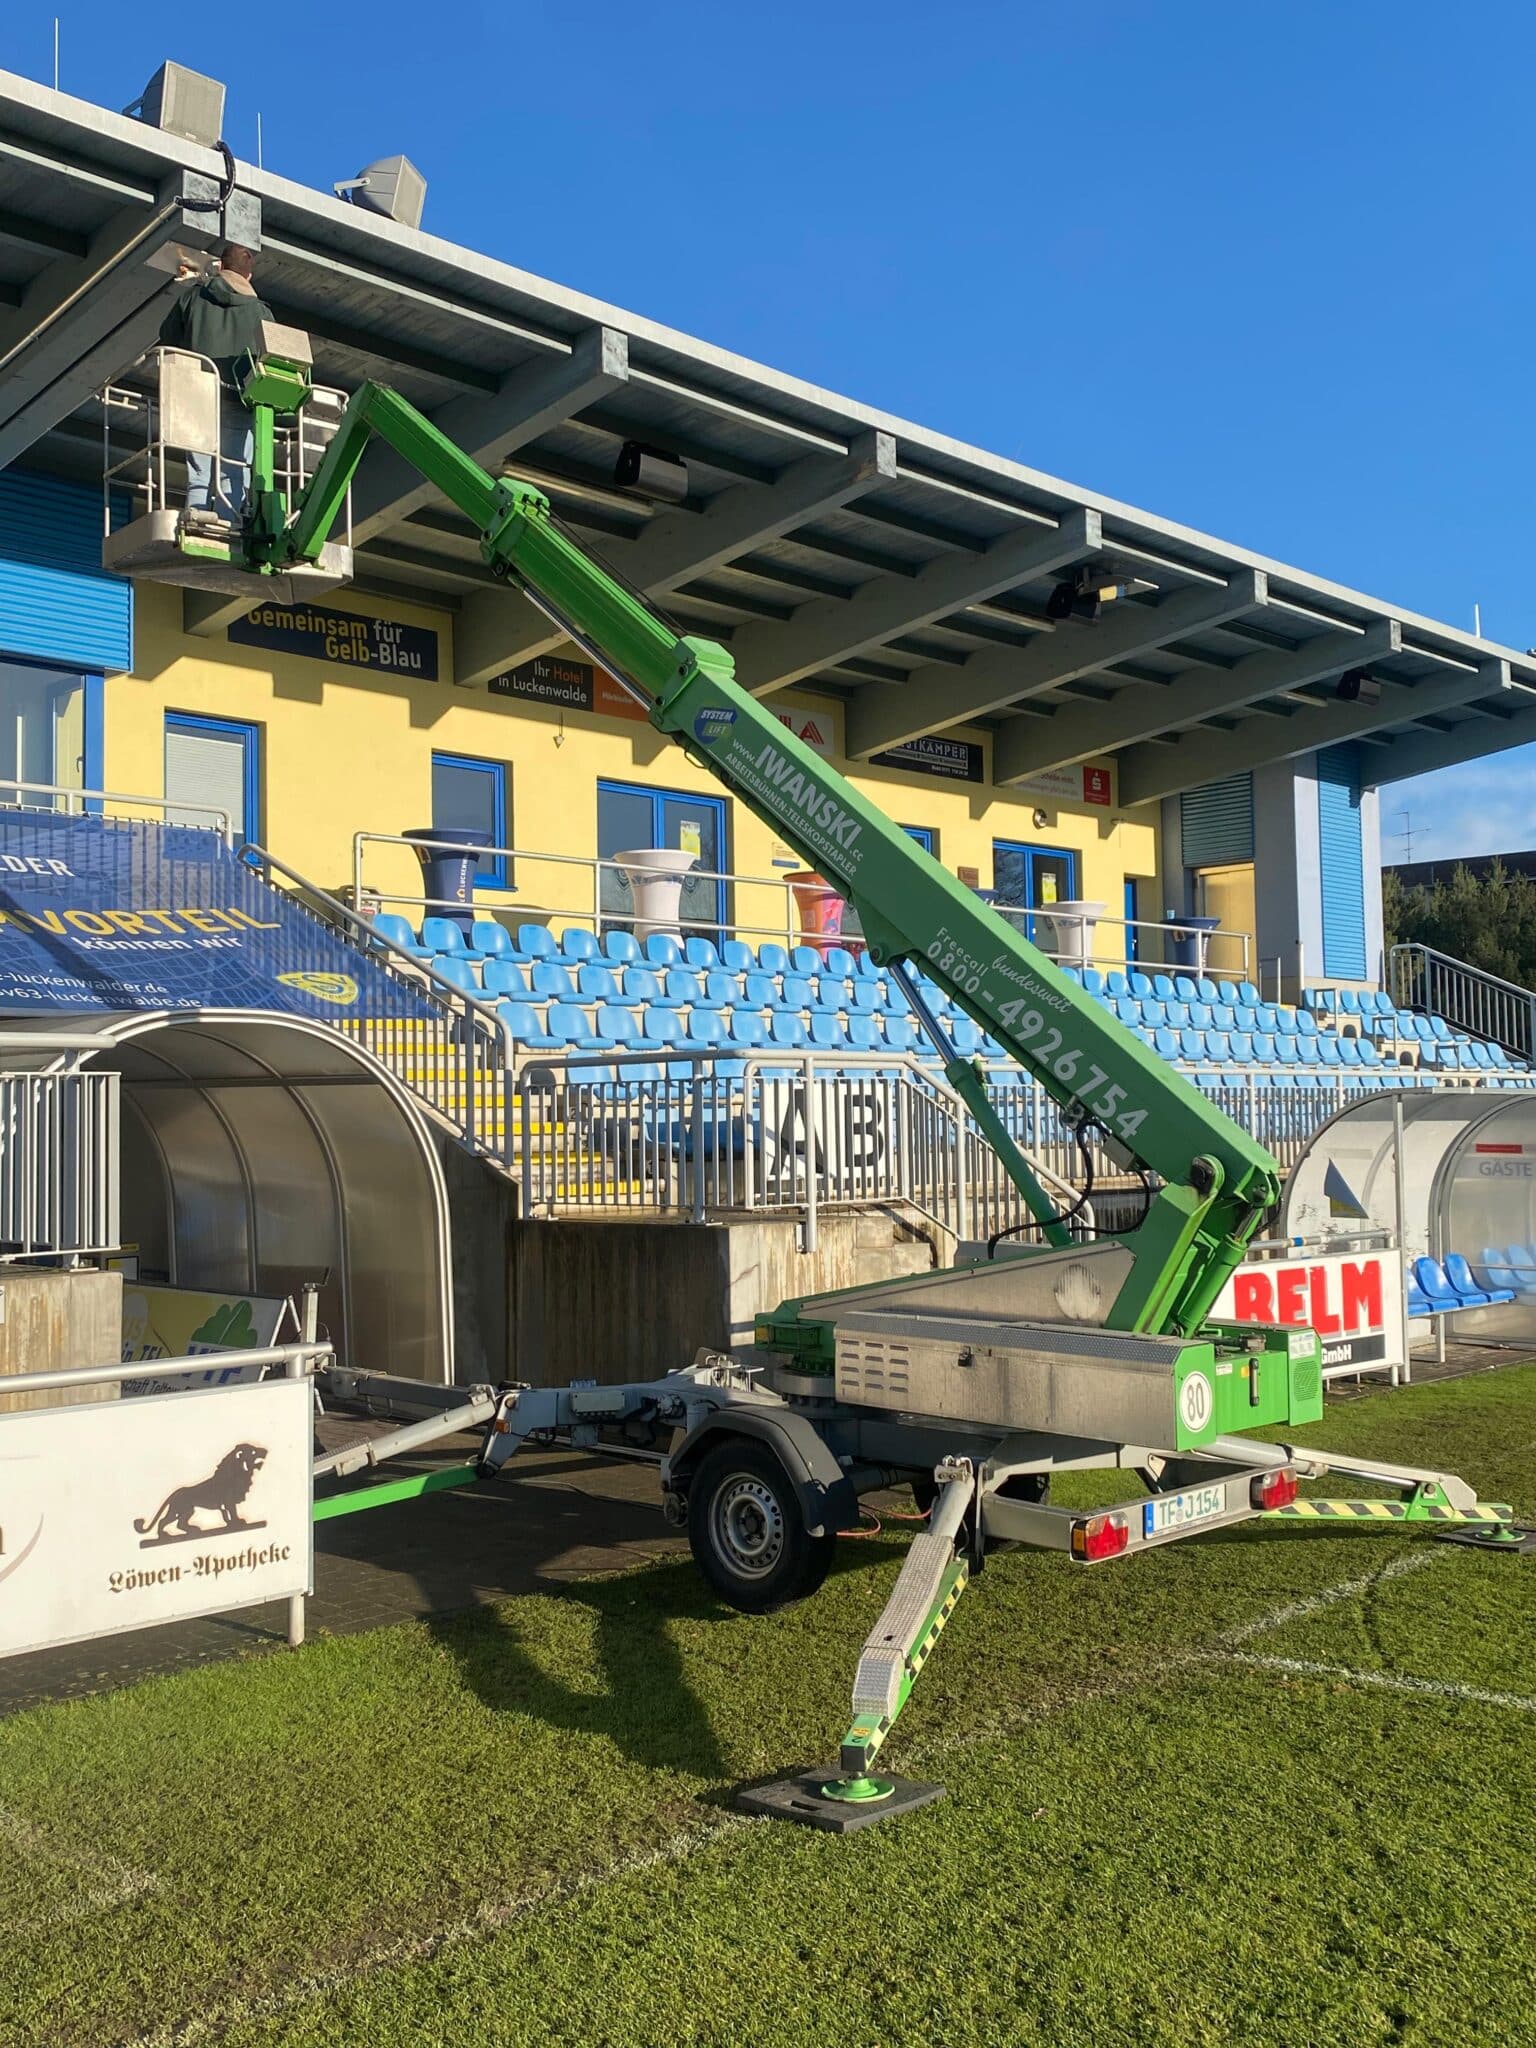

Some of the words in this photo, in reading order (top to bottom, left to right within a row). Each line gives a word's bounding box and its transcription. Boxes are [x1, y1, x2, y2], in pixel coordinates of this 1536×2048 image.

[248, 609, 368, 640] Gemeinsam
[373, 619, 403, 644] für
[325, 636, 422, 669] Gelb-Blau
[534, 661, 551, 677] Ihr
[553, 664, 584, 684] Hotel
[498, 676, 509, 687] in
[513, 674, 587, 703] Luckenwalde
[700, 709, 734, 722] SYSTEM
[708, 724, 728, 735] LIFT
[0, 855, 75, 877] DER
[70, 936, 193, 951] können
[193, 934, 244, 949] wir
[936, 926, 990, 977] Freecall
[992, 954, 1075, 1014] bundesweit
[1233, 1259, 1384, 1337] RELM
[1321, 1343, 1352, 1365] GmbH
[1186, 1381, 1205, 1423] 80
[1160, 1499, 1177, 1527] TF
[108, 1542, 291, 1594] Löwen-Apotheke
